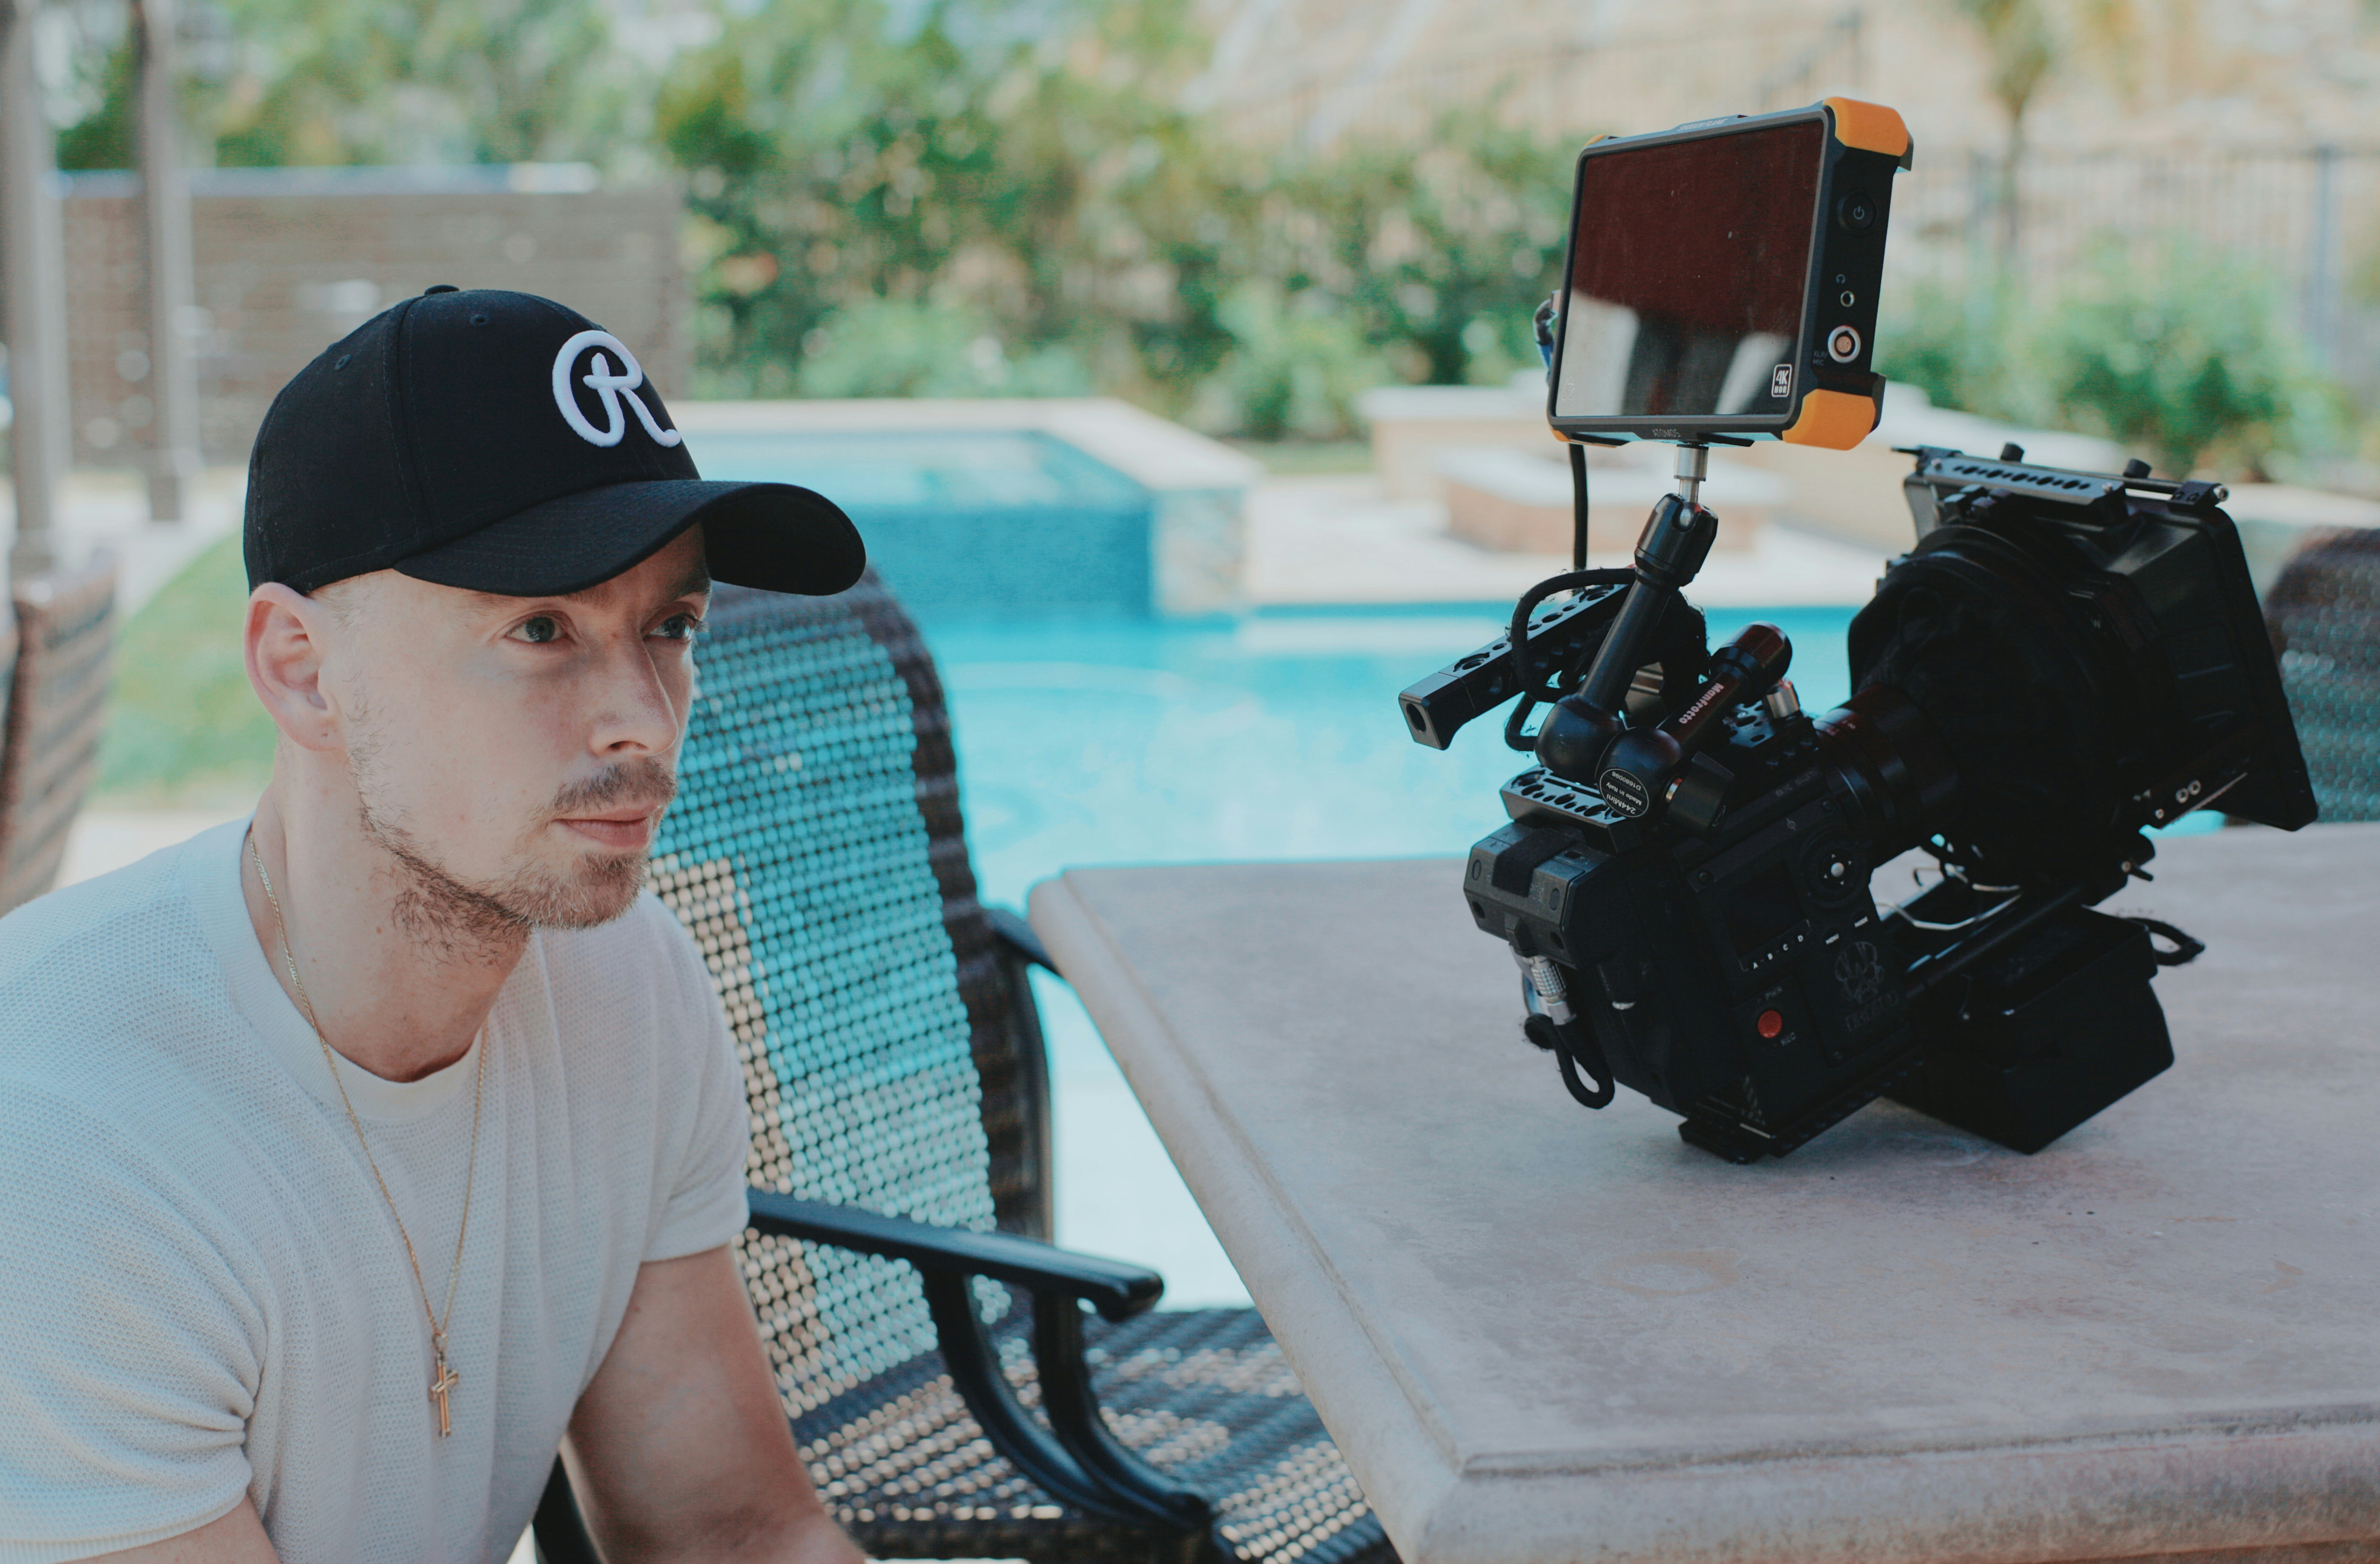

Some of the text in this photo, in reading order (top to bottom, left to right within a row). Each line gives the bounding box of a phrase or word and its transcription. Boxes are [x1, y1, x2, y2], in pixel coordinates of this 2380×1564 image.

[1775, 370, 1789, 385] 4K
[552, 330, 681, 448] R
[1774, 385, 1788, 394] HDR
[1652, 429, 1681, 437] ATOMOS
[1679, 683, 1724, 724] Manfrotto
[1606, 782, 1618, 793] Italy
[1606, 793, 1636, 814] 244Mini
[1626, 793, 1642, 806] Made
[1797, 934, 1804, 942] D
[1765, 986, 1782, 1001] PWR
